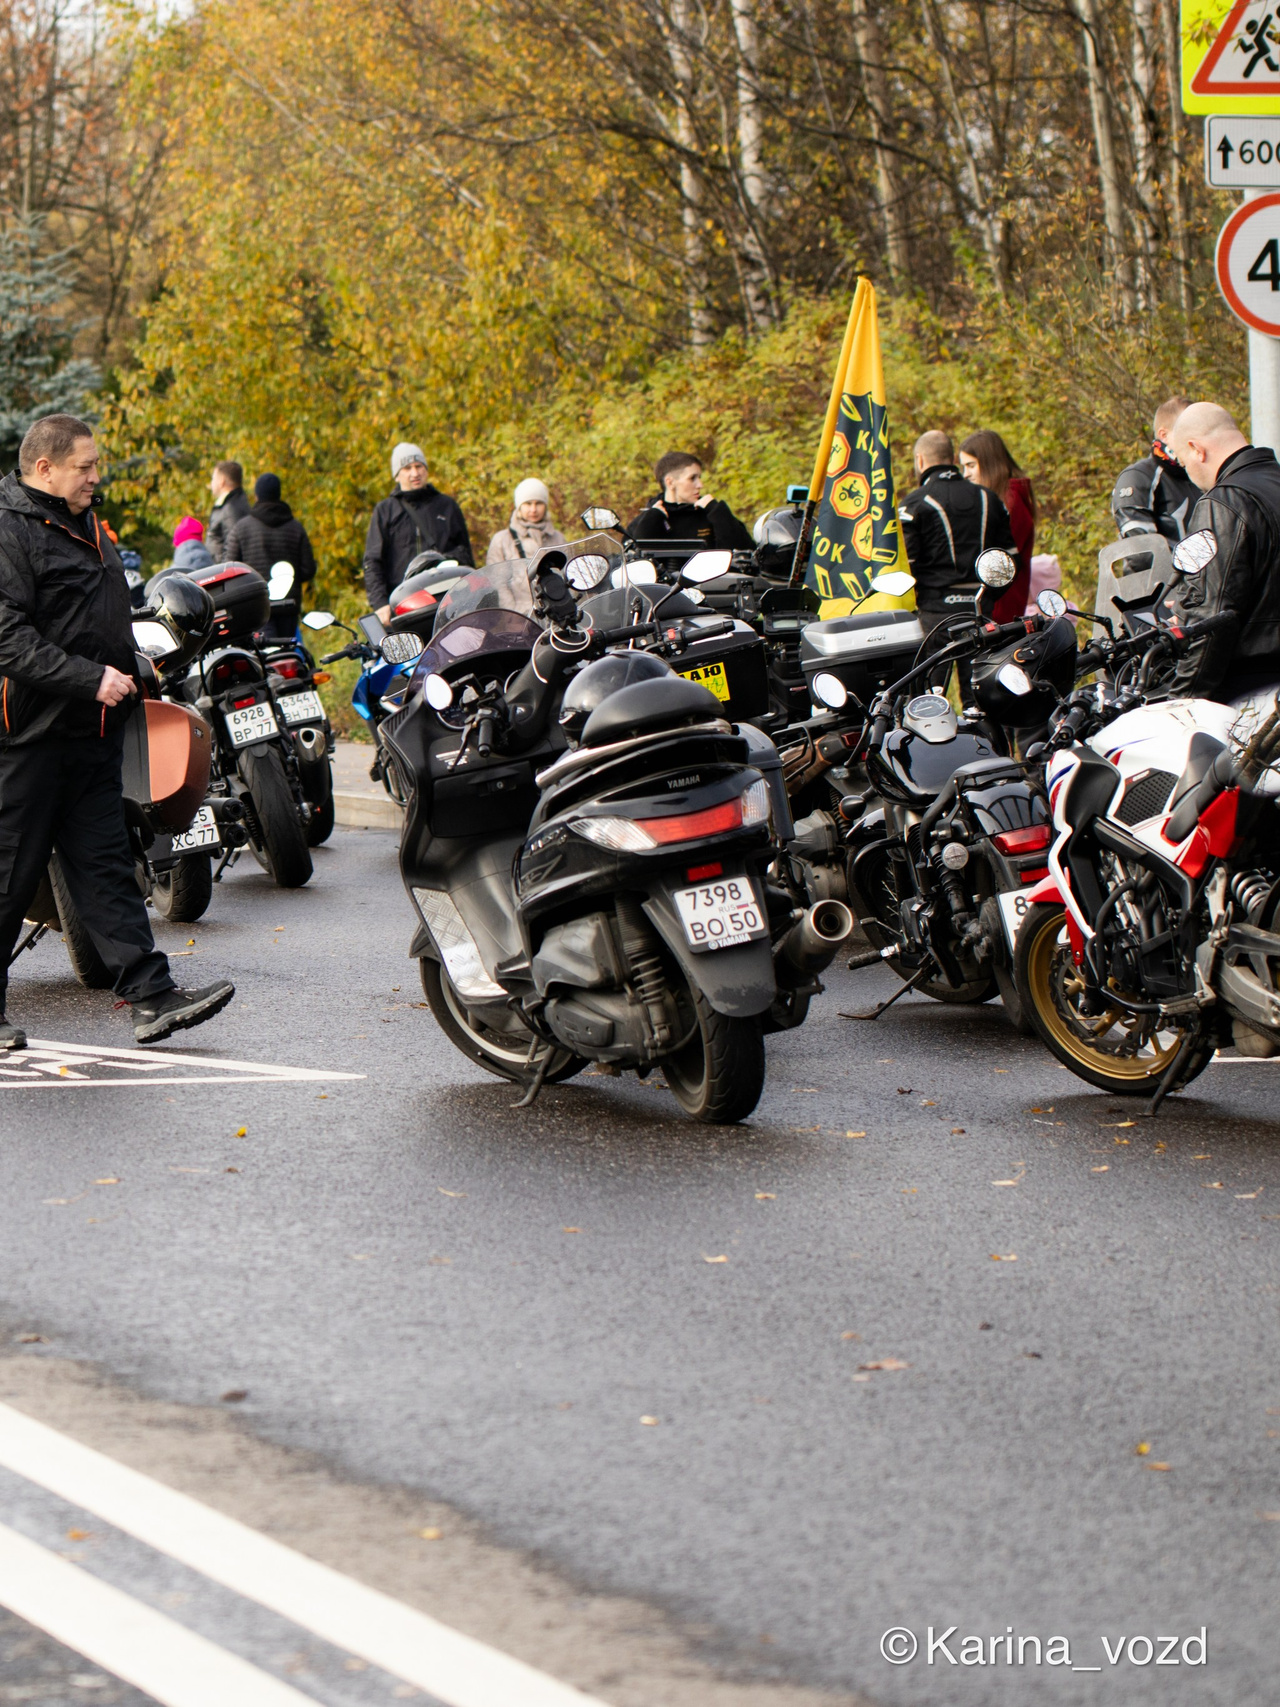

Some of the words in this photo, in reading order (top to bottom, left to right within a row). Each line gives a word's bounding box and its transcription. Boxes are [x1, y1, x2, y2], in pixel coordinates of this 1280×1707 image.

[281, 693, 310, 708] 6344
[233, 706, 265, 725] 6928
[257, 721, 272, 735] 77
[667, 774, 701, 789] YAMAHA
[198, 828, 214, 843] 77
[685, 883, 741, 910] 7398
[729, 910, 757, 931] 50
[717, 932, 751, 948] YAMAHA
